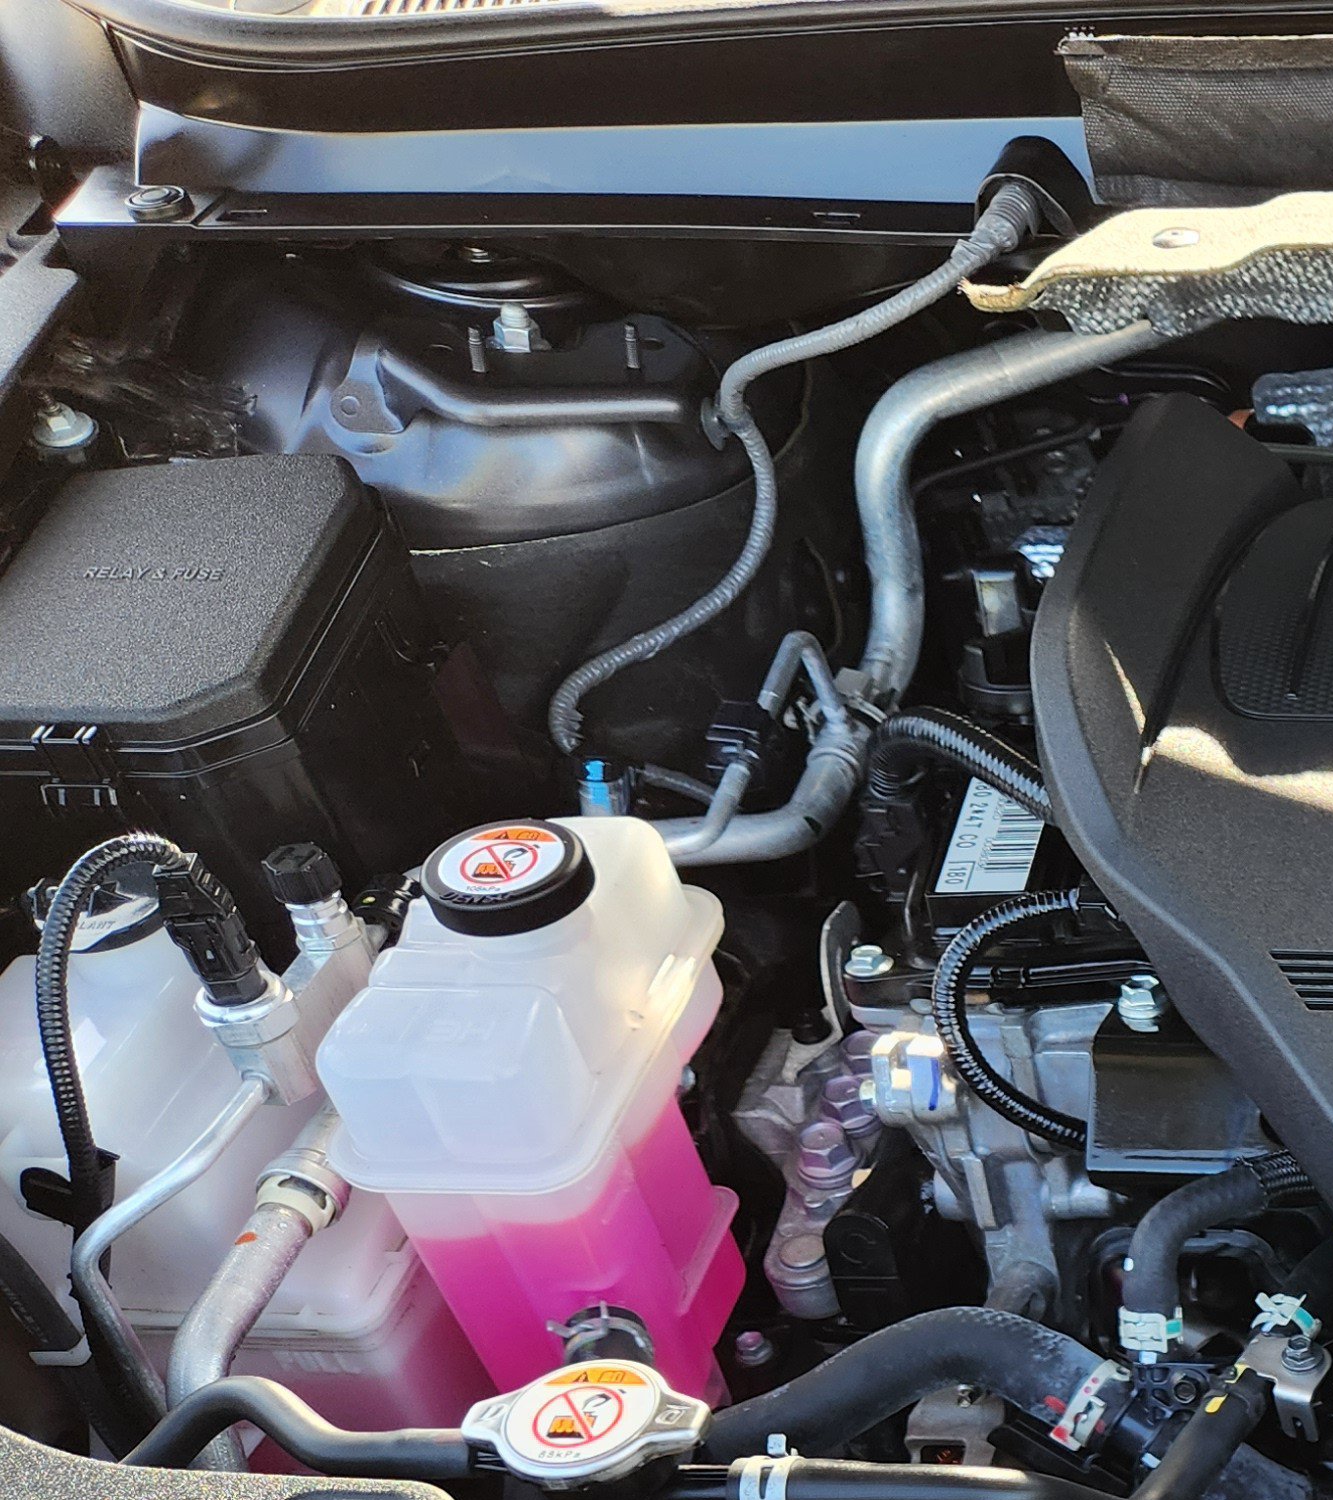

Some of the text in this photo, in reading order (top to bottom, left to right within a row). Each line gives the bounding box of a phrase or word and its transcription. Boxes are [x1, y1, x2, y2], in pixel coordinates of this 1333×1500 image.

[83, 566, 225, 581] RELAY & FUSE
